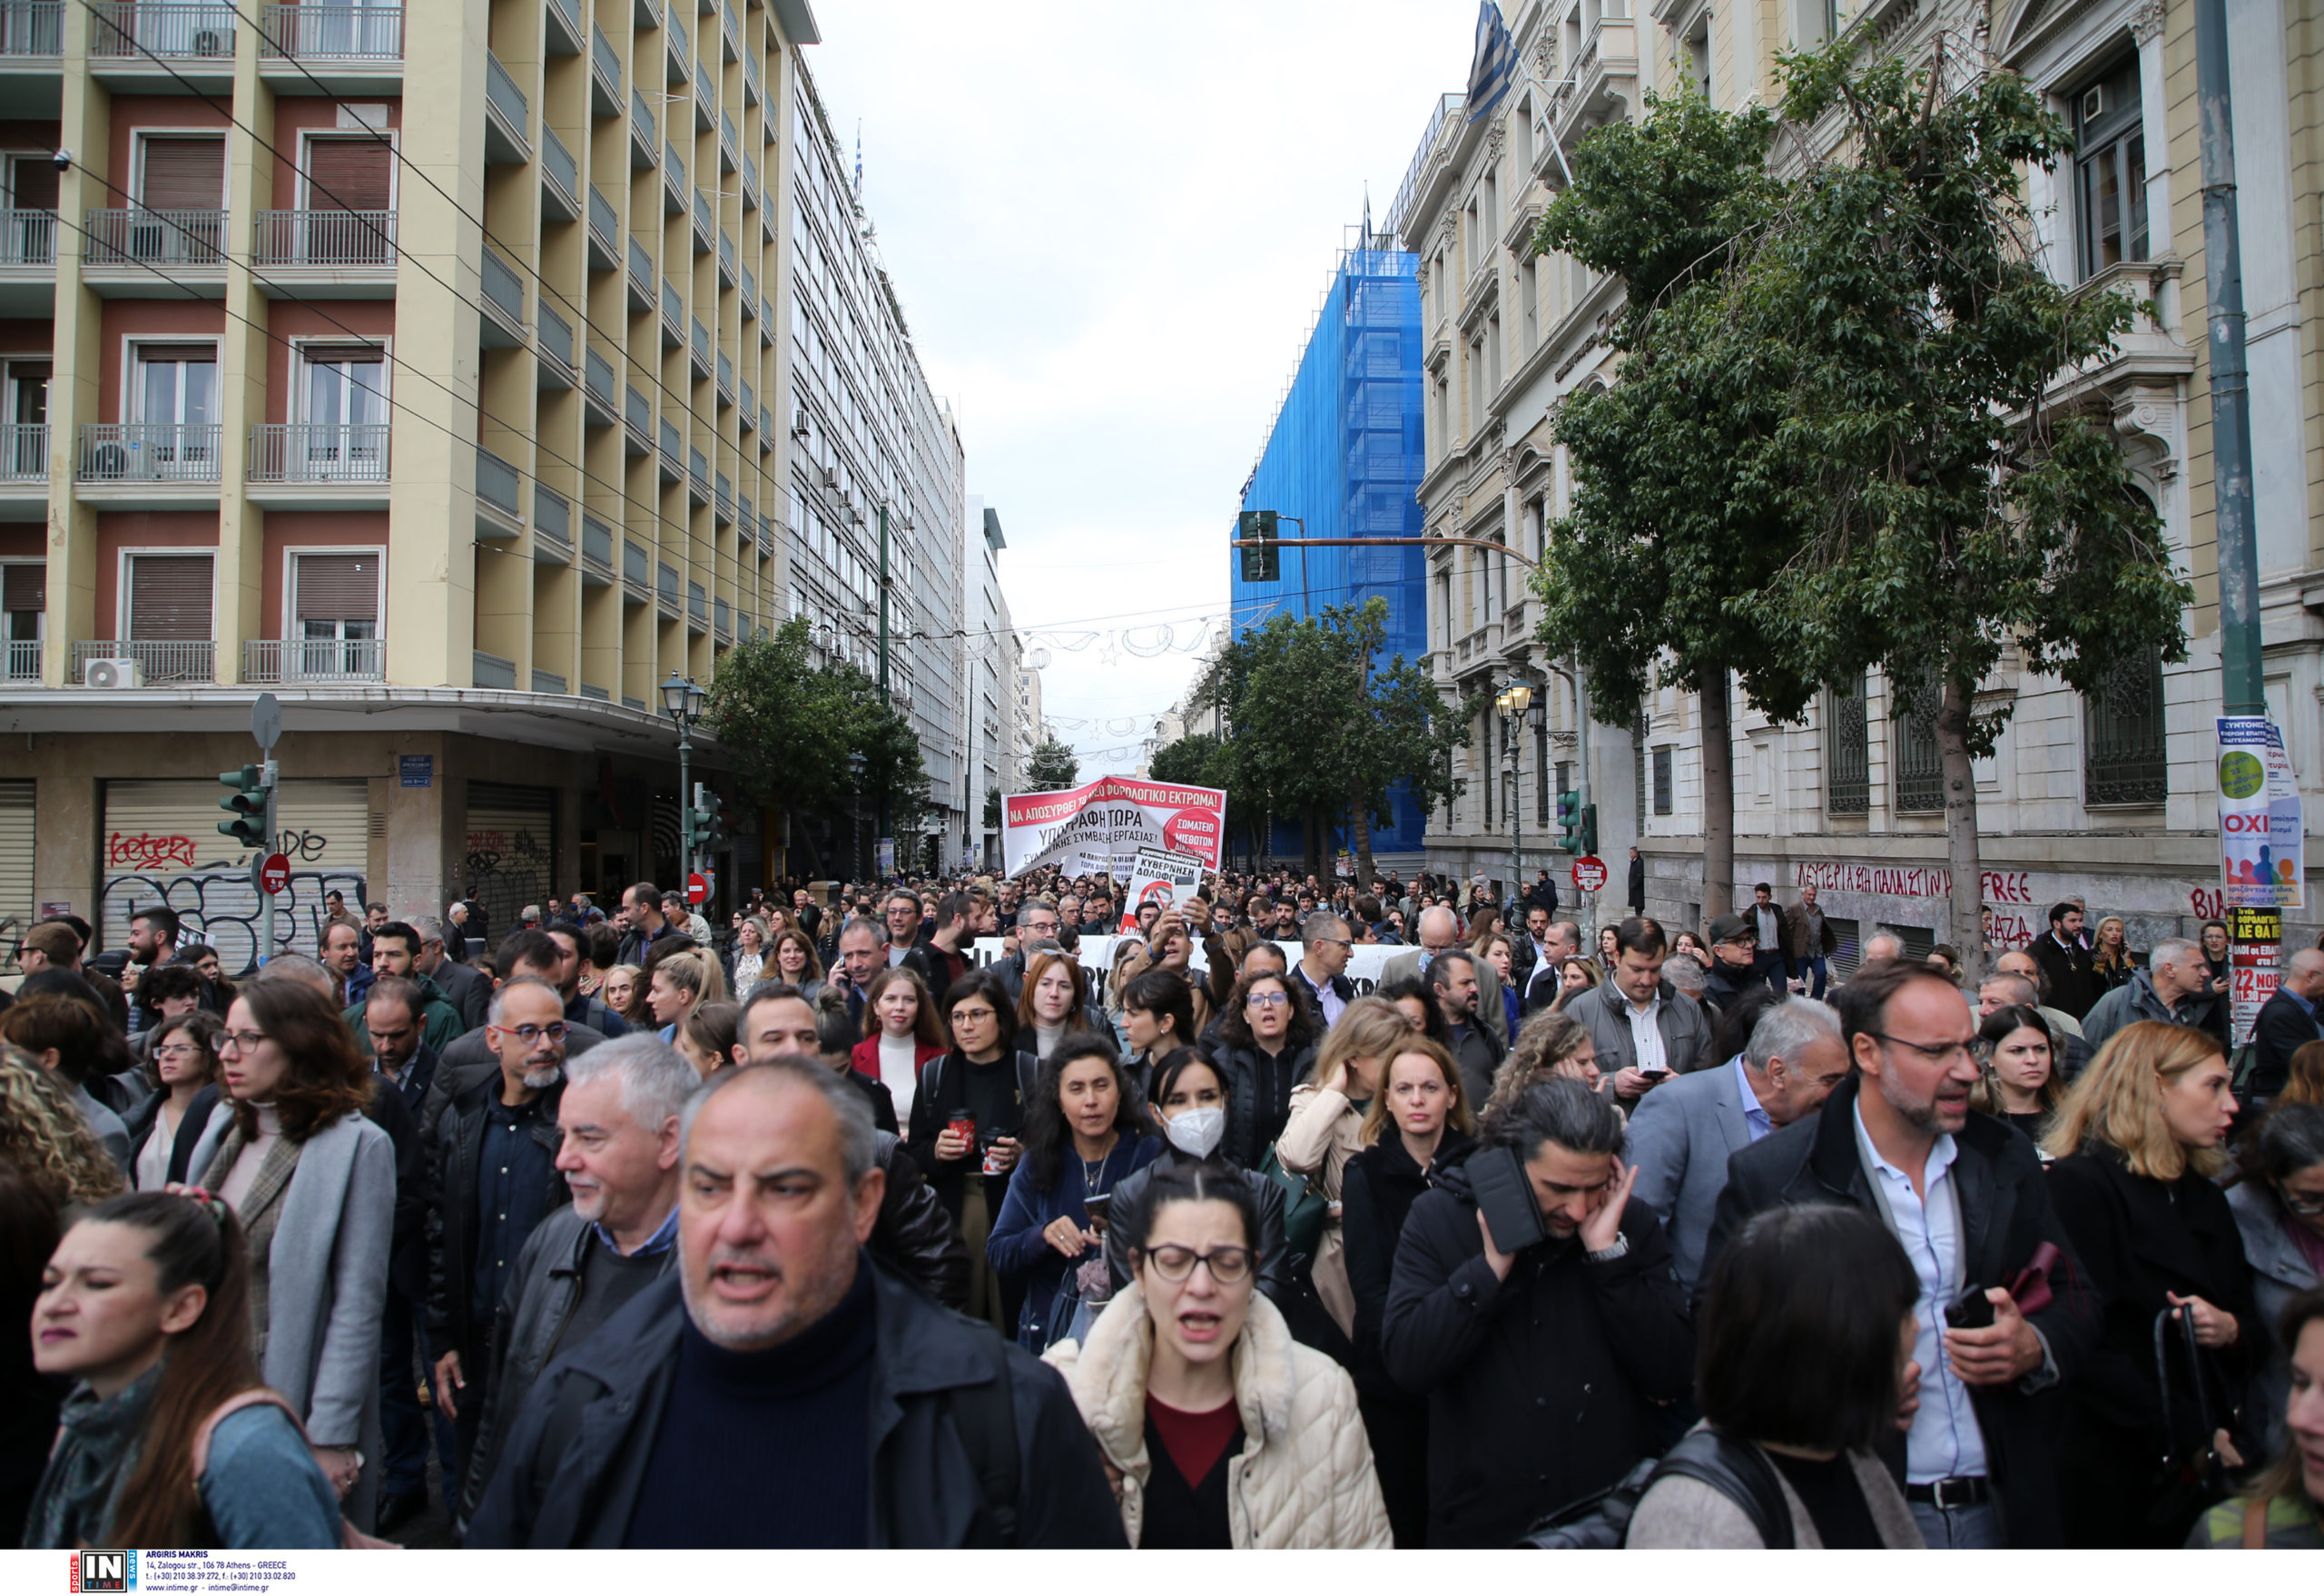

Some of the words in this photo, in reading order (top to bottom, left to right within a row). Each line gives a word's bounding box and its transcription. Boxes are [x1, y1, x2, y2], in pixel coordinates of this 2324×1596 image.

[1009, 810, 1024, 823] ΝΑ
[1025, 799, 1077, 822] ΑΠΟΣΥΡΘΕΙ
[1107, 784, 1167, 803] ΦΟΡΟΛΟΓΙΚΟ
[1168, 790, 1218, 808] ΕΚΤΡΩΜΑ!
[1039, 810, 1107, 846] ΥΠΟΓΡΑΦΗ
[1108, 809, 1143, 828] ΤΩΡΑ
[1177, 818, 1215, 833] ΣΩΜΑΤΕΙΟ
[2225, 814, 2269, 832] ΟΧΙ
[1114, 830, 1157, 844] ΕΡΓΑΣΙΑΣ!
[1175, 832, 1214, 847] ΜΙΣΘΩΤΩΝ
[1140, 858, 1195, 877] ΚΥΒΕΡΝΗΣΗ
[1980, 871, 2032, 903] FREE
[1988, 914, 2033, 948] AZA
[2238, 924, 2253, 938] ΔΕ
[2254, 924, 2271, 938] ΘΑ
[2234, 969, 2254, 991] 22
